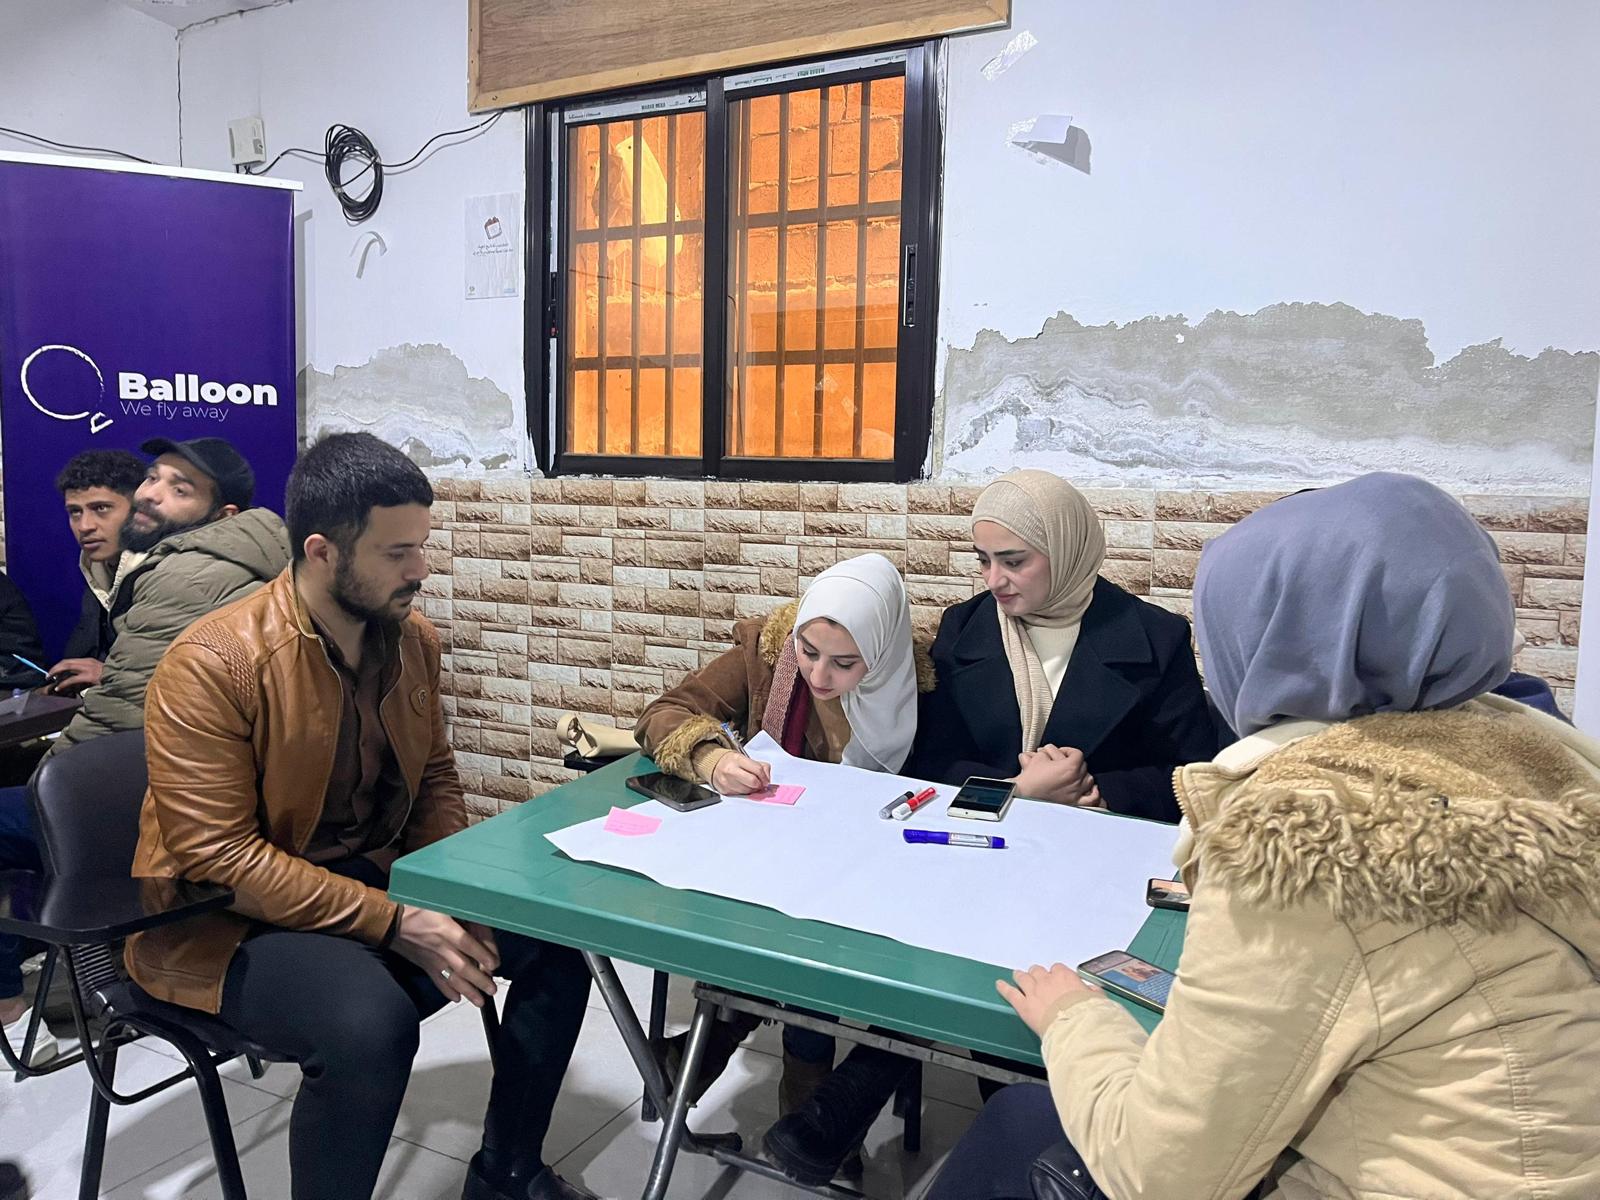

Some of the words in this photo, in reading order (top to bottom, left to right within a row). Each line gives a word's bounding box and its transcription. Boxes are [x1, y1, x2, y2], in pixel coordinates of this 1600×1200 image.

[118, 371, 278, 406] Balloon
[120, 400, 151, 416] We
[156, 401, 178, 420] fly
[182, 405, 229, 422] away
